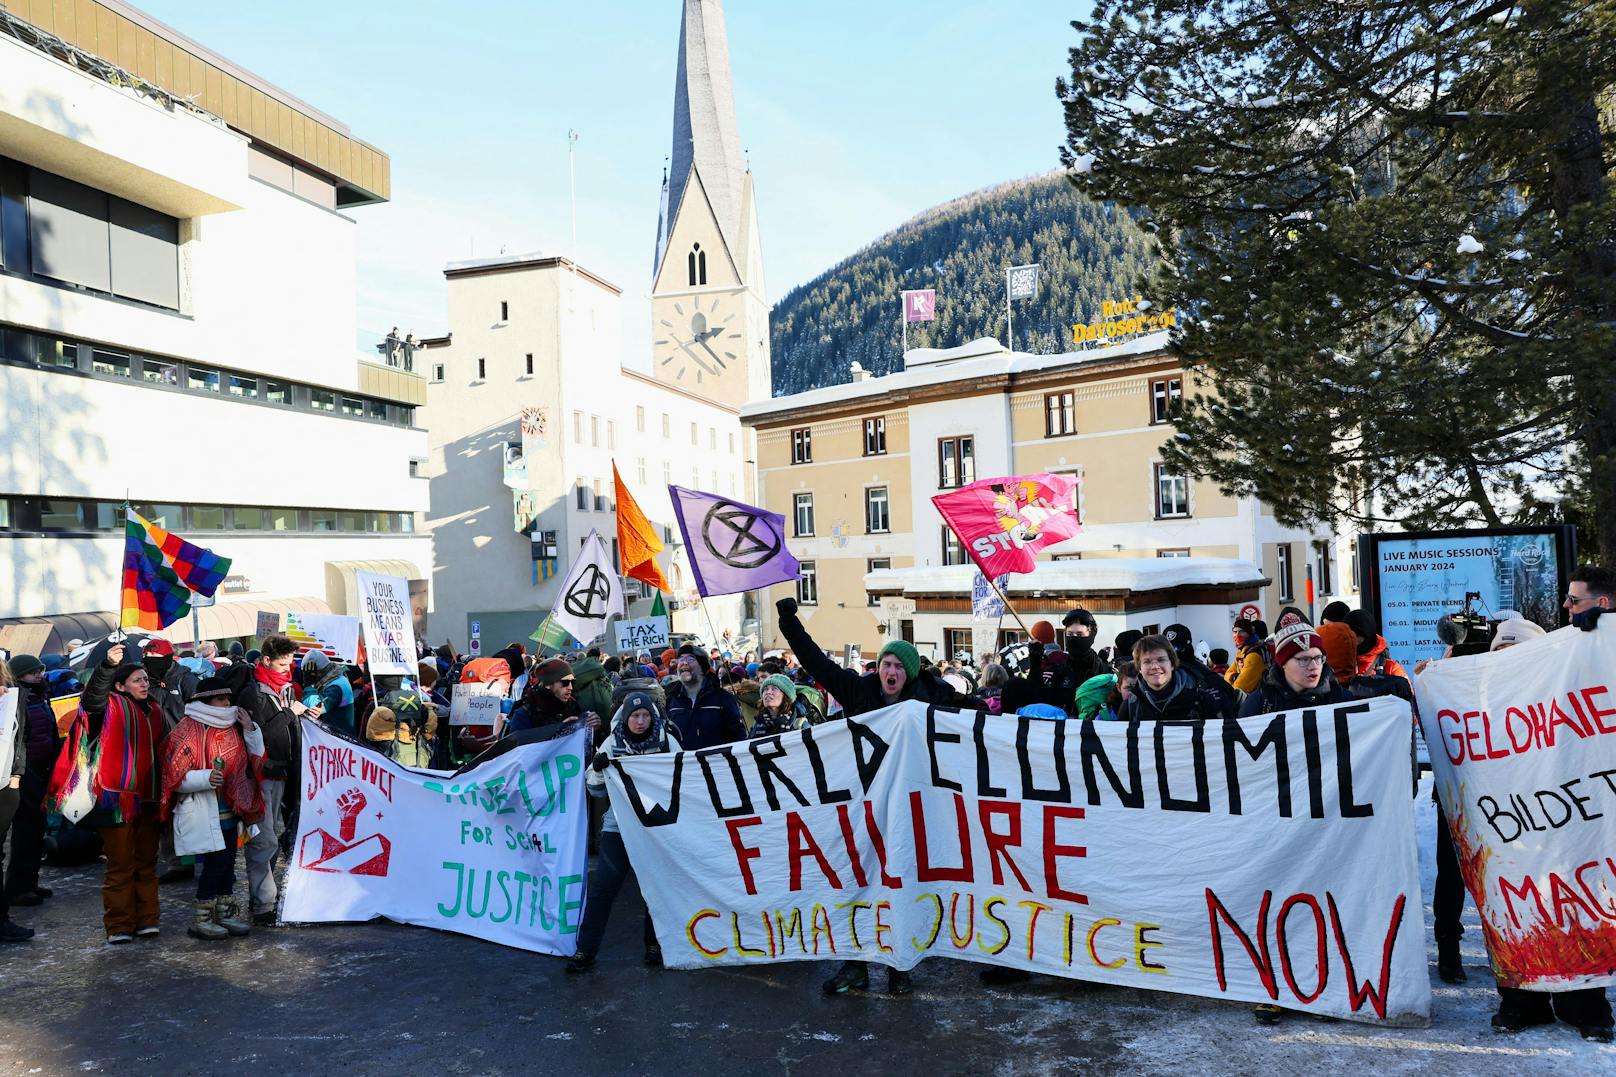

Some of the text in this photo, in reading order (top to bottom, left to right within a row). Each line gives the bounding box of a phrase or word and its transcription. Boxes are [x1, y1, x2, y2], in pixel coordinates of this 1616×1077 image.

[1383, 547, 1500, 561] LIVE MUSIC SESSIONS
[1384, 562, 1456, 572] JANUARY 2024
[372, 581, 395, 599] YOUR
[370, 614, 403, 631] MEANS
[626, 623, 658, 637] TAX
[374, 631, 404, 647] WAR
[621, 633, 666, 649] THE RICH
[308, 745, 357, 801] STRIKE
[611, 702, 1375, 827] WORLD ECONOMIC
[518, 754, 581, 818] UP
[461, 820, 493, 846] FOR
[725, 790, 1089, 905] FAILURE
[1498, 856, 1616, 931] MAC
[686, 887, 1406, 1020] CLIMATE JUSTICE NOW
